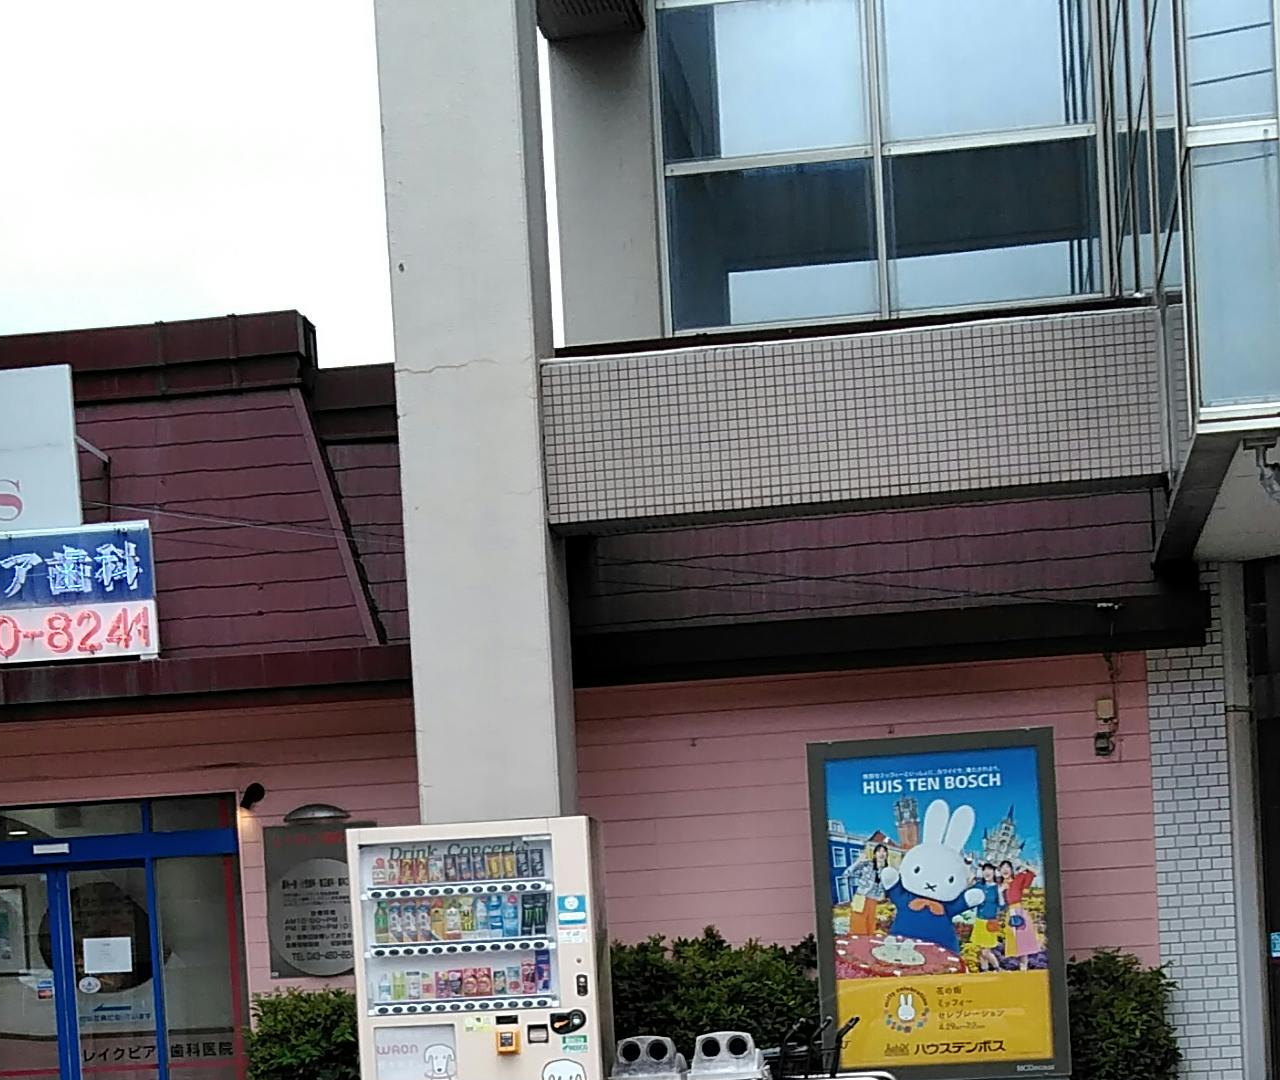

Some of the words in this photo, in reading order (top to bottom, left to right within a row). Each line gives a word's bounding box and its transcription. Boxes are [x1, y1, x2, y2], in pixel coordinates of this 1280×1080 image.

[862, 779, 903, 795] HUIS
[906, 776, 940, 792] TEN
[944, 773, 1001, 790] BOSCH
[389, 844, 439, 862] Drink
[82, 1044, 156, 1063] レイクピア
[170, 1041, 234, 1058] 歯科医院
[913, 1040, 1006, 1056] ハウステンボス
